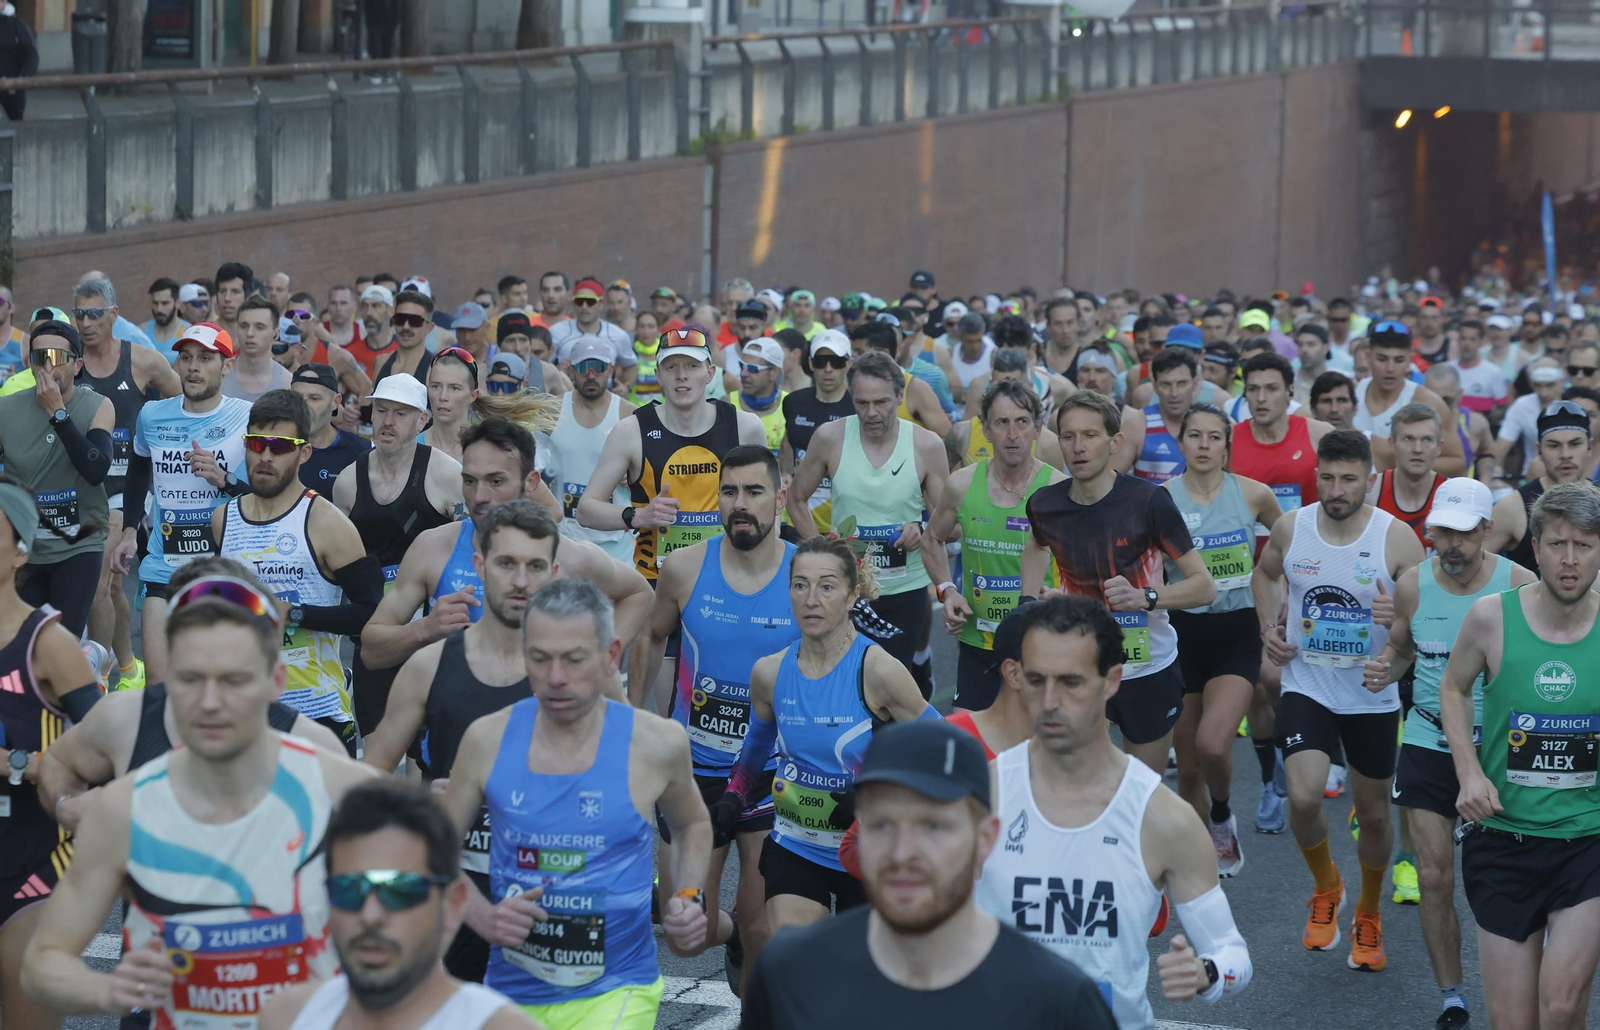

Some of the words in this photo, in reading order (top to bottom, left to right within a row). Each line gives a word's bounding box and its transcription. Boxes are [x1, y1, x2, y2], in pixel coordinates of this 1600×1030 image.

[668, 462, 718, 476] STRIDERS
[38, 491, 70, 502] ZURICH
[179, 511, 214, 521] ZURICH
[681, 515, 718, 523] ZURICH
[182, 529, 201, 538] 3020
[681, 532, 702, 541] 2158
[1208, 534, 1242, 546] ZURICH
[178, 540, 209, 553] LUDO
[1211, 553, 1230, 562] 2524
[253, 561, 304, 580] Training
[992, 596, 1011, 605] 2684
[1325, 609, 1364, 620] ZURICH
[1326, 628, 1346, 638] 7710
[1308, 638, 1364, 654] ALBERTO
[1543, 684, 1566, 692] CHAC
[719, 705, 743, 718] 3242
[700, 713, 750, 737] CARLO
[1541, 719, 1590, 729] ZURICH
[1541, 740, 1568, 751] 3127
[1531, 754, 1575, 770] ALEX
[801, 772, 846, 788] ZURICH
[799, 795, 824, 808] 2690
[775, 805, 802, 825] LAURA
[804, 817, 837, 830] CLAV
[529, 833, 606, 848] AUXERRE
[518, 850, 536, 864] LA
[541, 853, 583, 867] TOUR
[536, 894, 592, 911] URICH
[1012, 876, 1118, 938] ENA
[208, 923, 287, 948] ZURICH
[554, 948, 604, 965] GUYON
